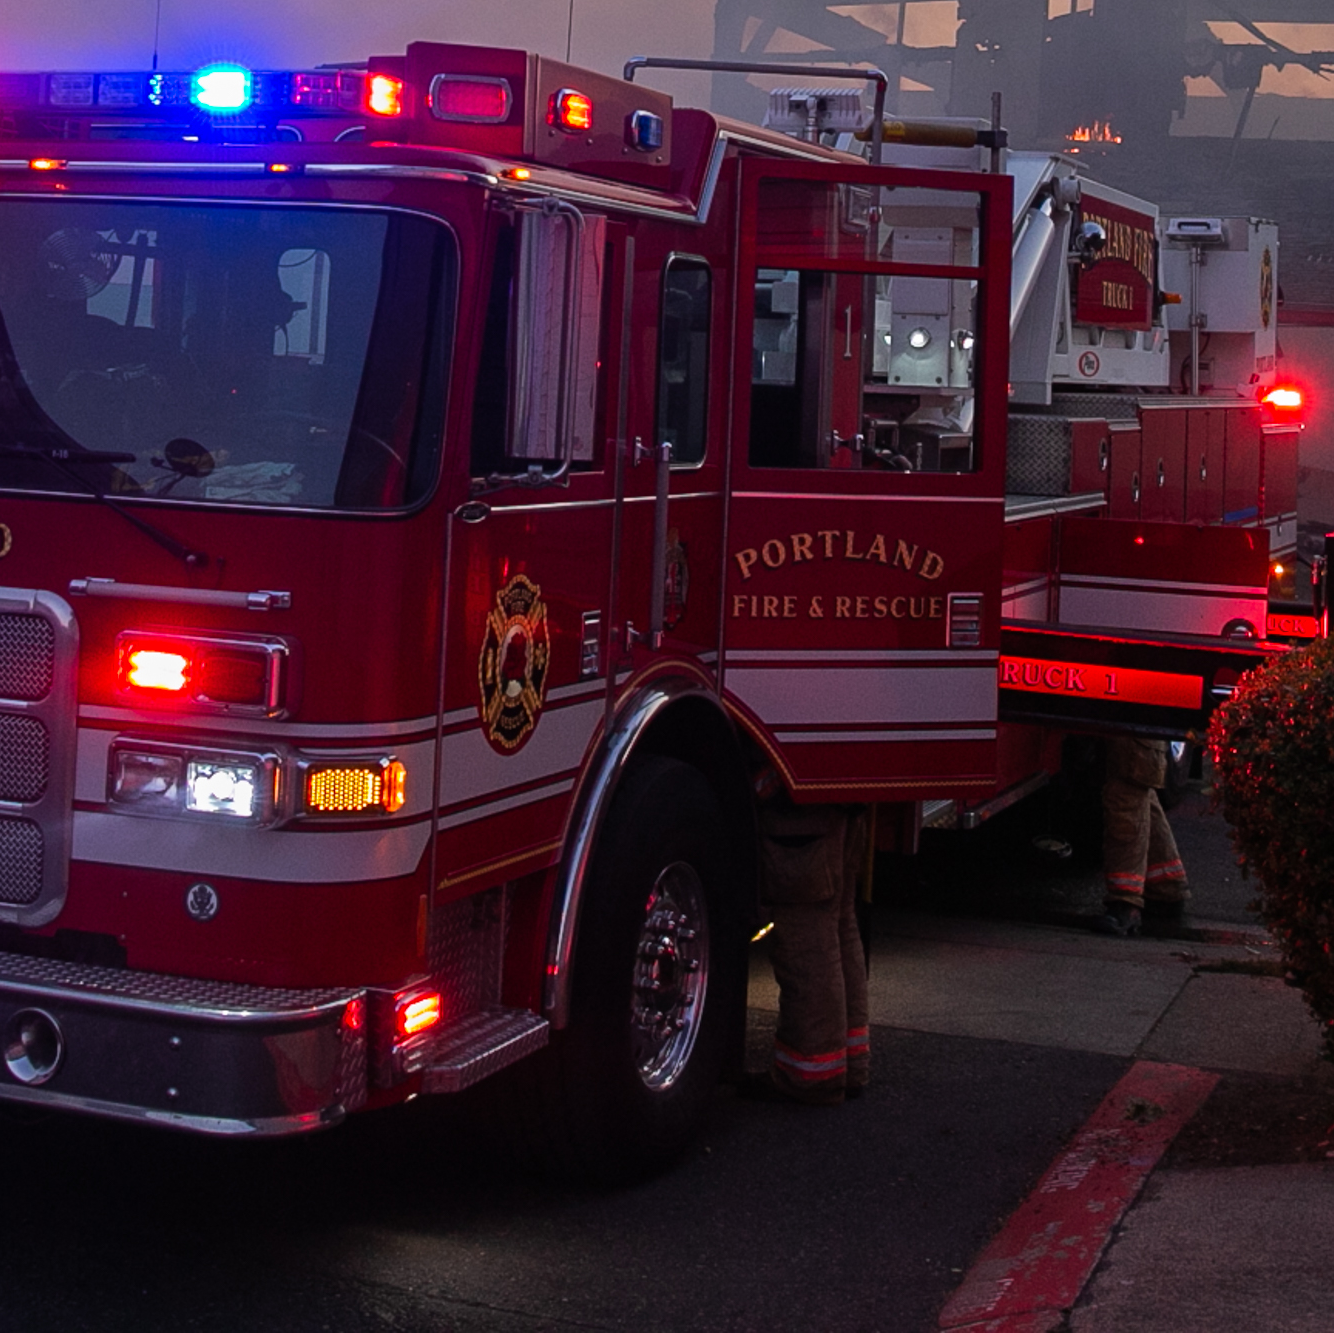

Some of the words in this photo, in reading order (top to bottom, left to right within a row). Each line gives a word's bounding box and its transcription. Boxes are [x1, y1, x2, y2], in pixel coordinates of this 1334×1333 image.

[1134, 227, 1154, 285] FIRE
[1102, 281, 1128, 309] TRUCK
[1129, 285, 1134, 310] 1
[734, 530, 945, 580] PORTLAND
[732, 594, 798, 618] FIRE
[808, 595, 824, 618] &
[835, 595, 944, 619] RESCUE
[1267, 617, 1305, 632] UCK
[999, 661, 1085, 691] RUCK
[1106, 672, 1117, 694] 1
